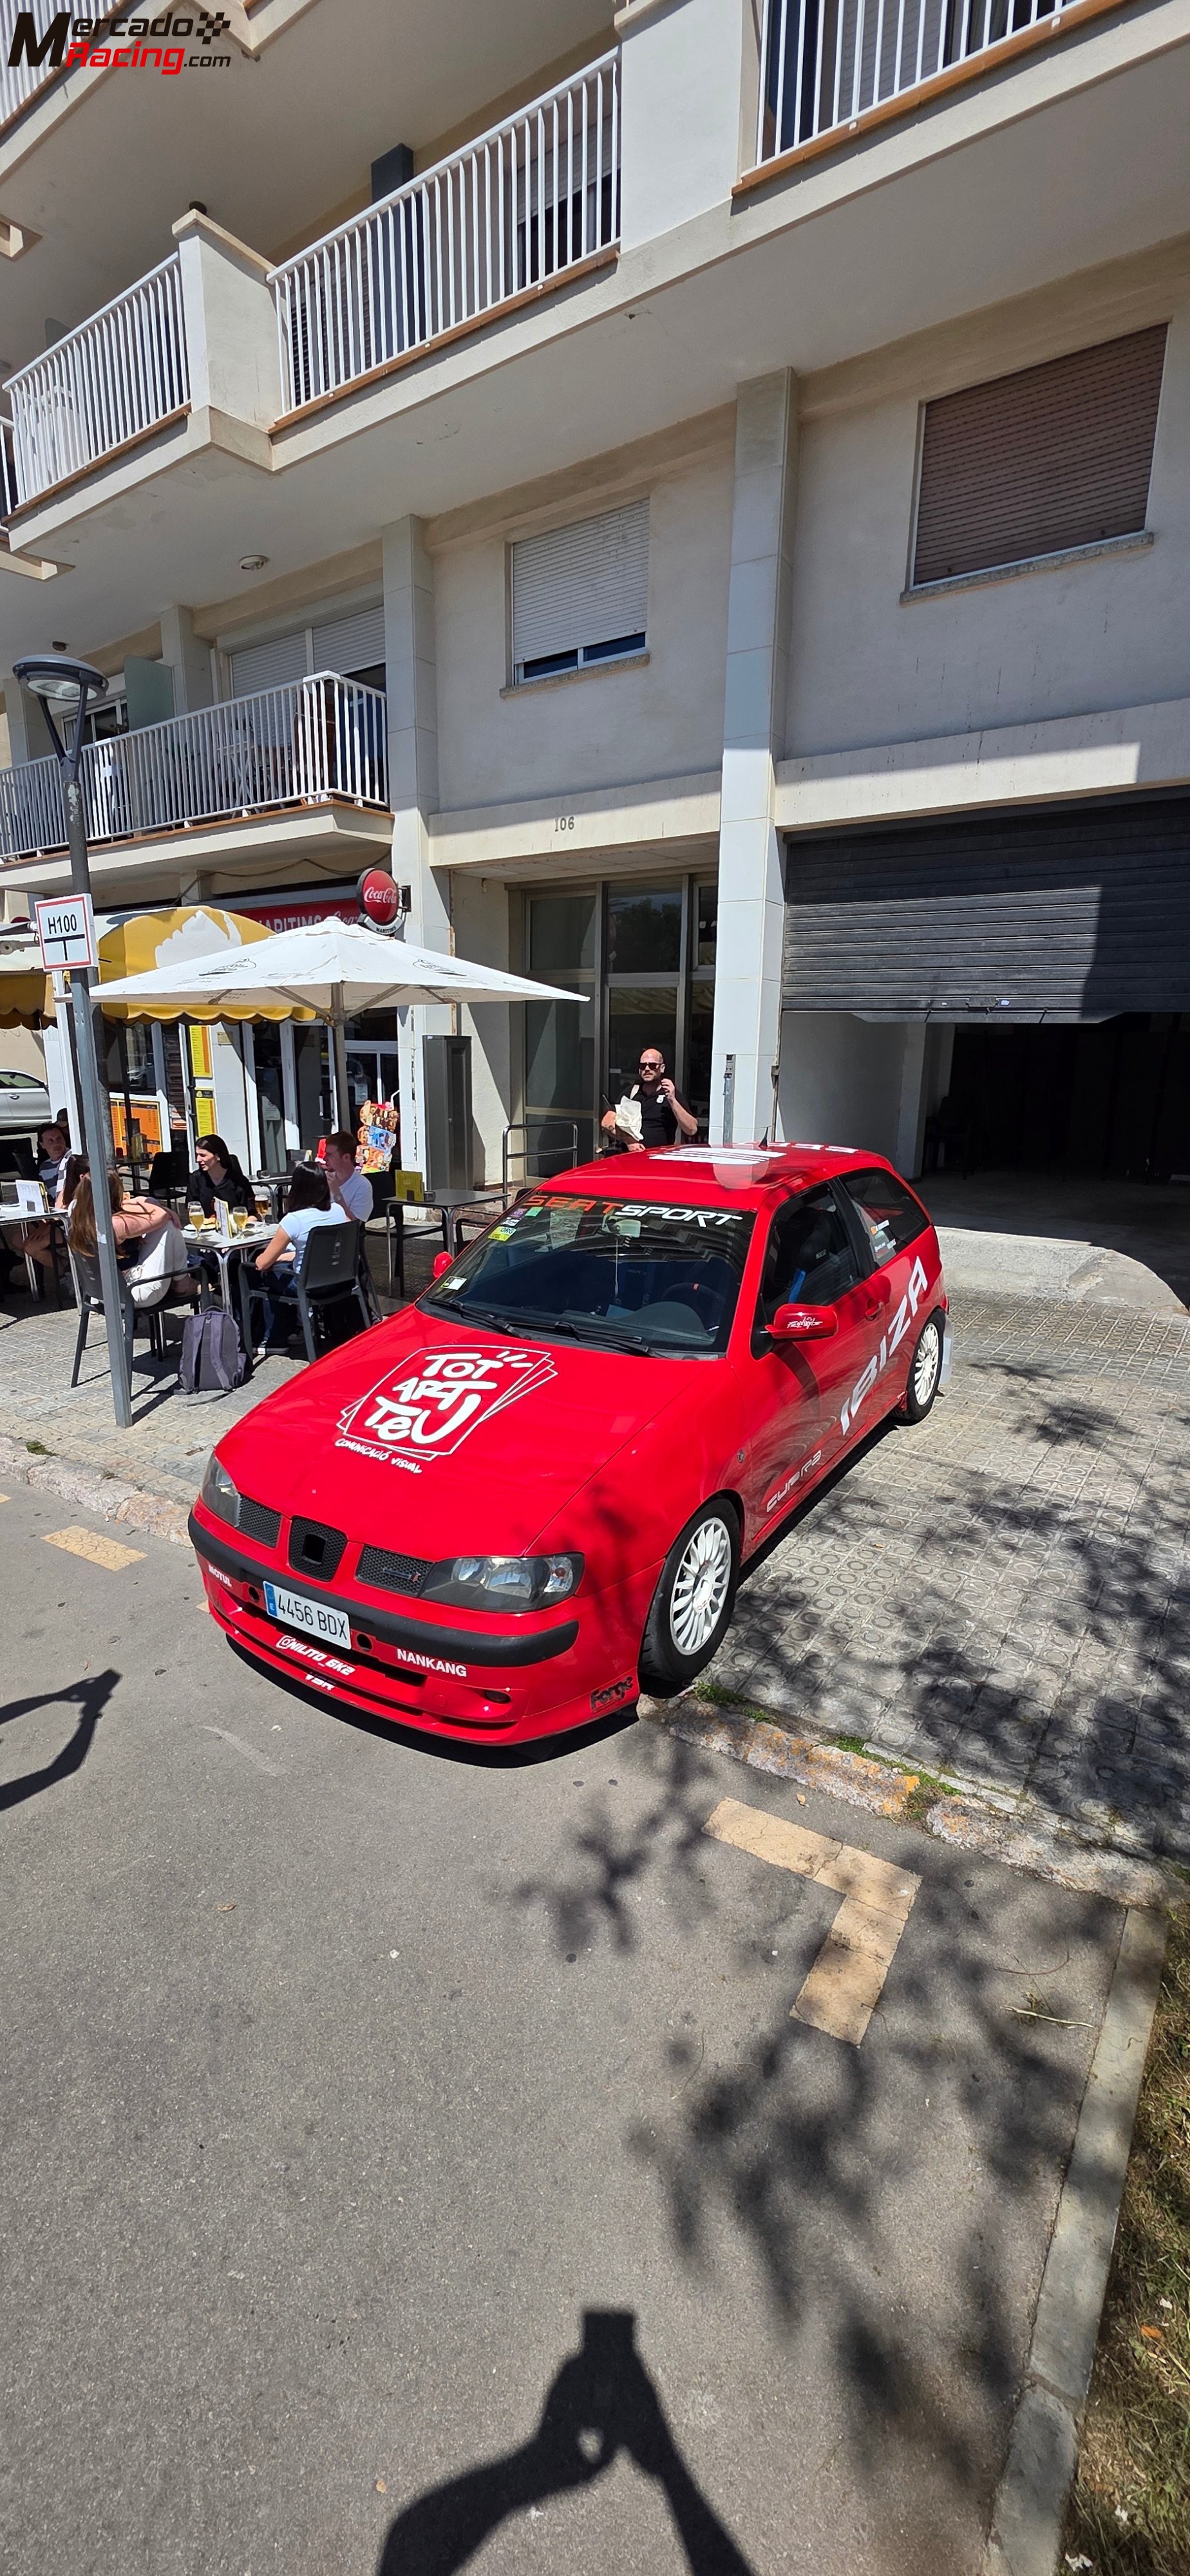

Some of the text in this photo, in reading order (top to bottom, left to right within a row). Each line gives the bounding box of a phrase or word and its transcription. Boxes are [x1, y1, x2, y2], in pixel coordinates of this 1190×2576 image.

[554, 816, 574, 831] 106
[48, 914, 77, 934] H100
[840, 1255, 928, 1435] IBIZA
[392, 1378, 498, 1410] ART
[208, 1564, 232, 1587] MOTUL
[278, 1595, 314, 1625] 4456
[317, 1610, 347, 1640] BDX
[397, 1648, 467, 1677] NANKANG
